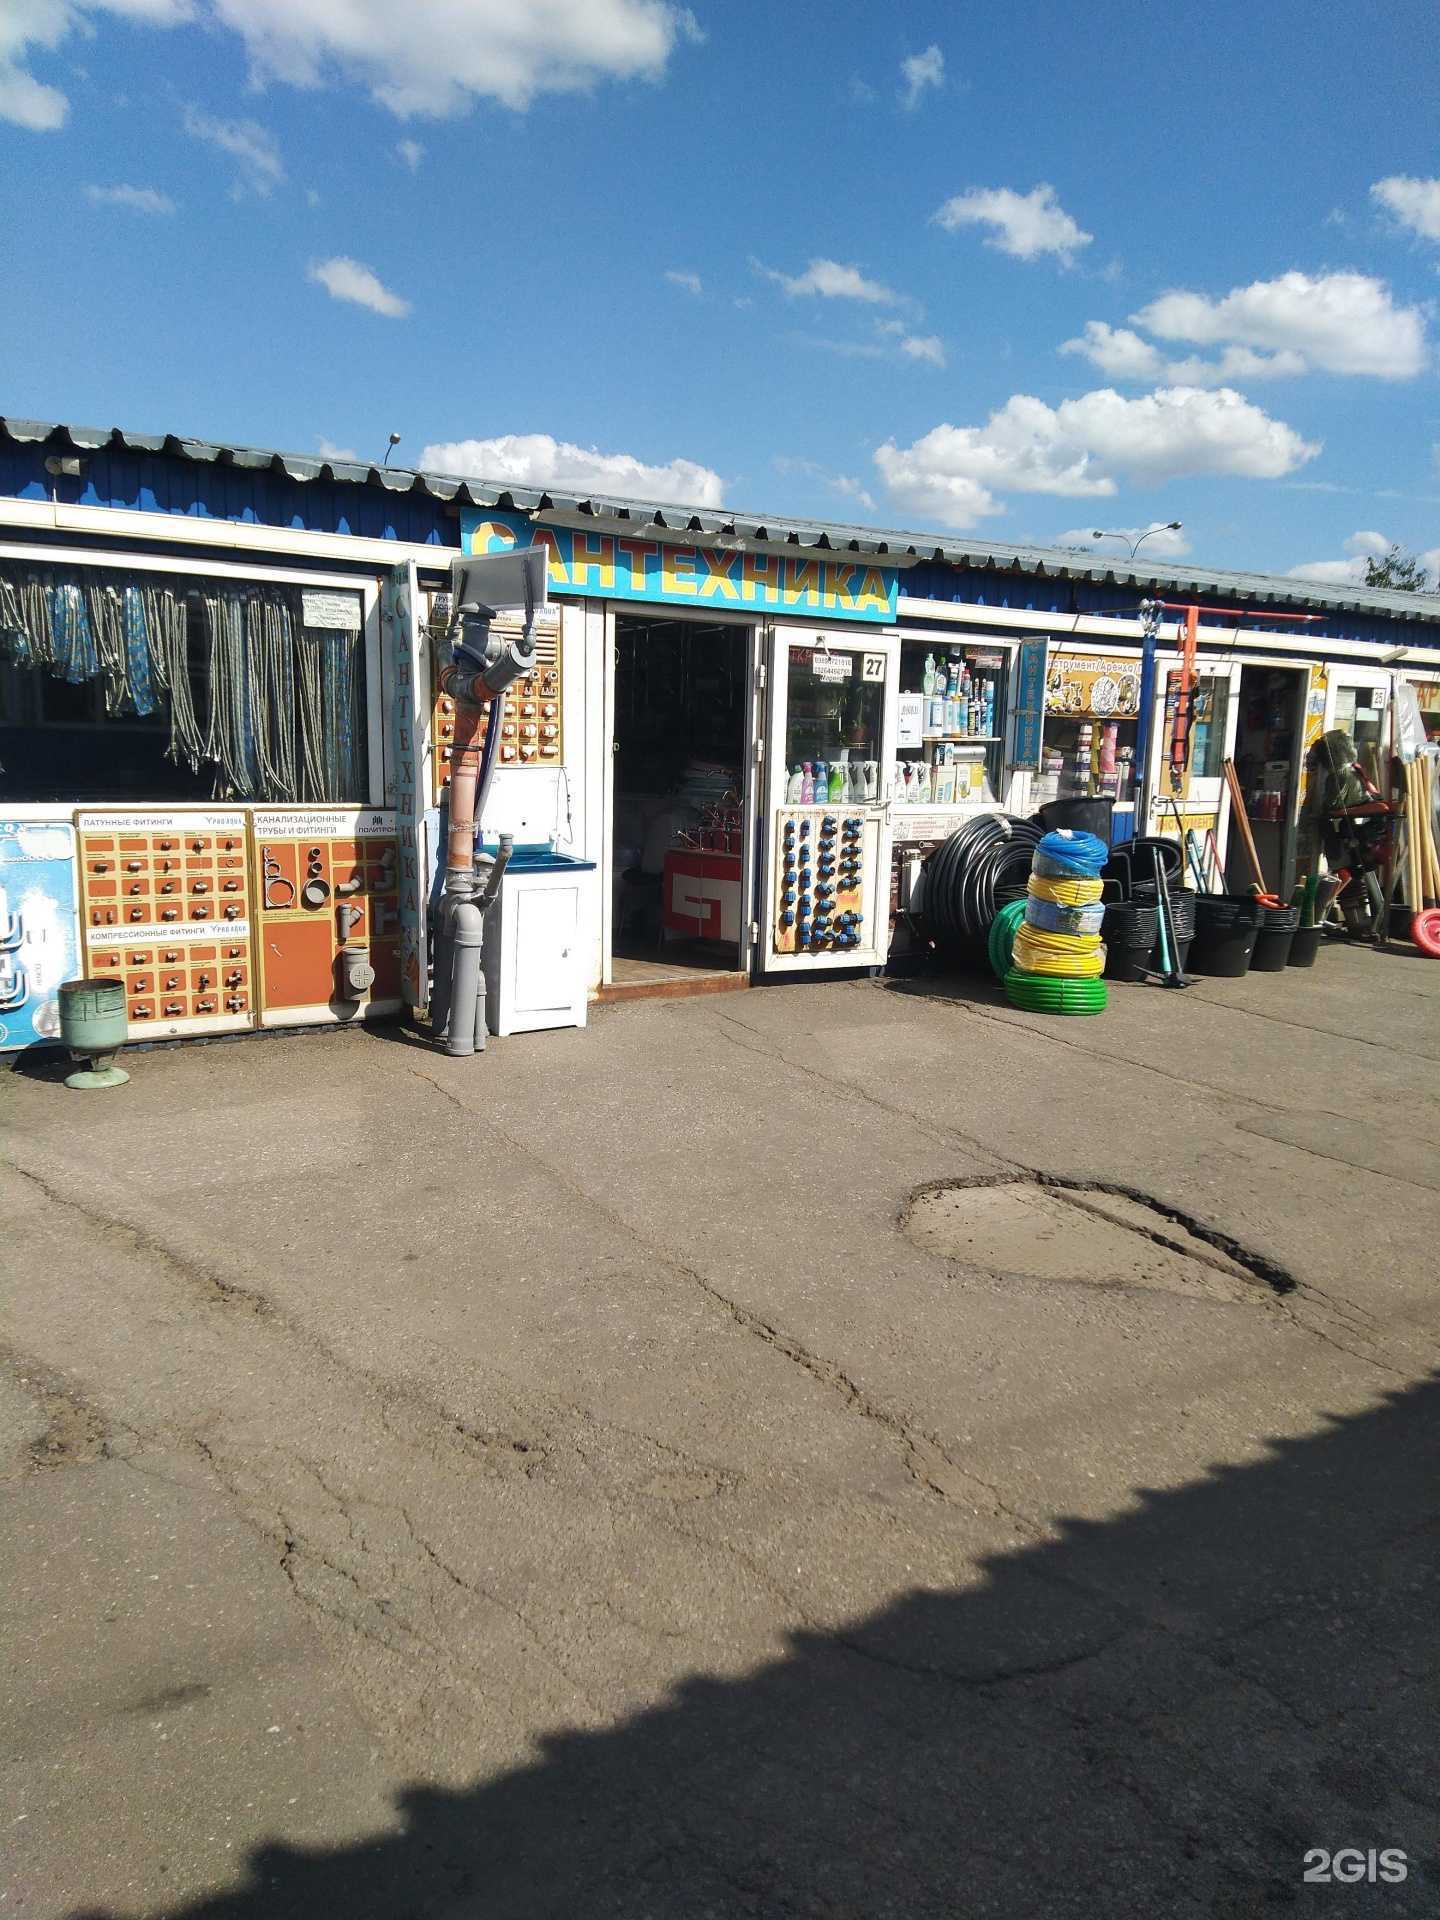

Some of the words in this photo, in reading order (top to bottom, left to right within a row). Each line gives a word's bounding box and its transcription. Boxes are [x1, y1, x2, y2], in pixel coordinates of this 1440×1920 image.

[471, 521, 890, 613] САНТЕХНИКА
[866, 659, 883, 676] 27
[395, 595, 416, 911] САНТЕХНИКА
[132, 818, 173, 826] ФИТИНГИ
[257, 816, 347, 824] КАНАЛИЗАЦИОННЫЕ
[258, 827, 286, 835] ТРУБЫ
[296, 826, 337, 835] ФИТИНГИ
[91, 929, 168, 940] КОМПРЕССИОННЫЕ
[169, 926, 206, 936] ФИТИНГИ
